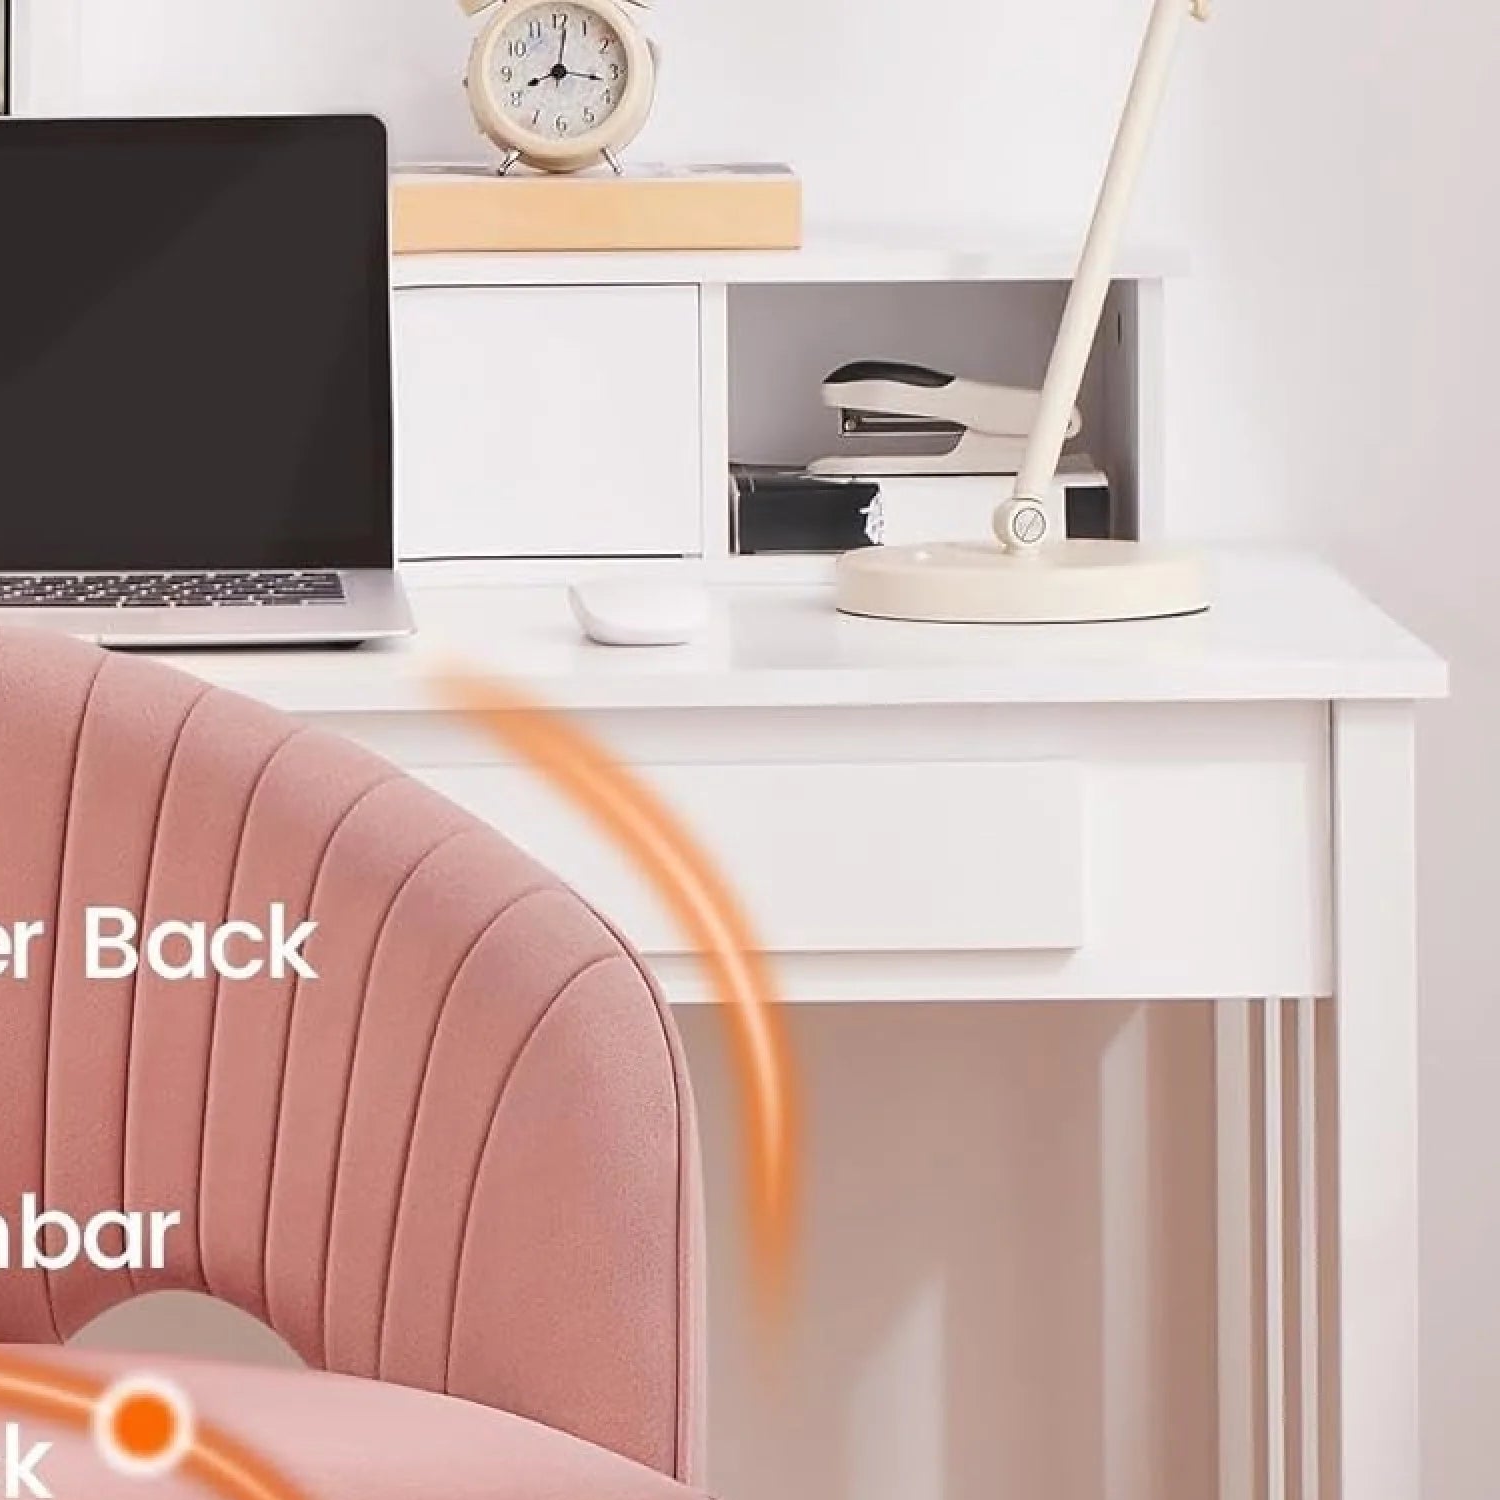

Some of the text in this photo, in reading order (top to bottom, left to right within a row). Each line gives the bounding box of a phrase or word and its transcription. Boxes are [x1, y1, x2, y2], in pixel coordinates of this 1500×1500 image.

[528, 21, 541, 37] 11
[508, 41, 526, 57] 10
[501, 66, 512, 81] 9
